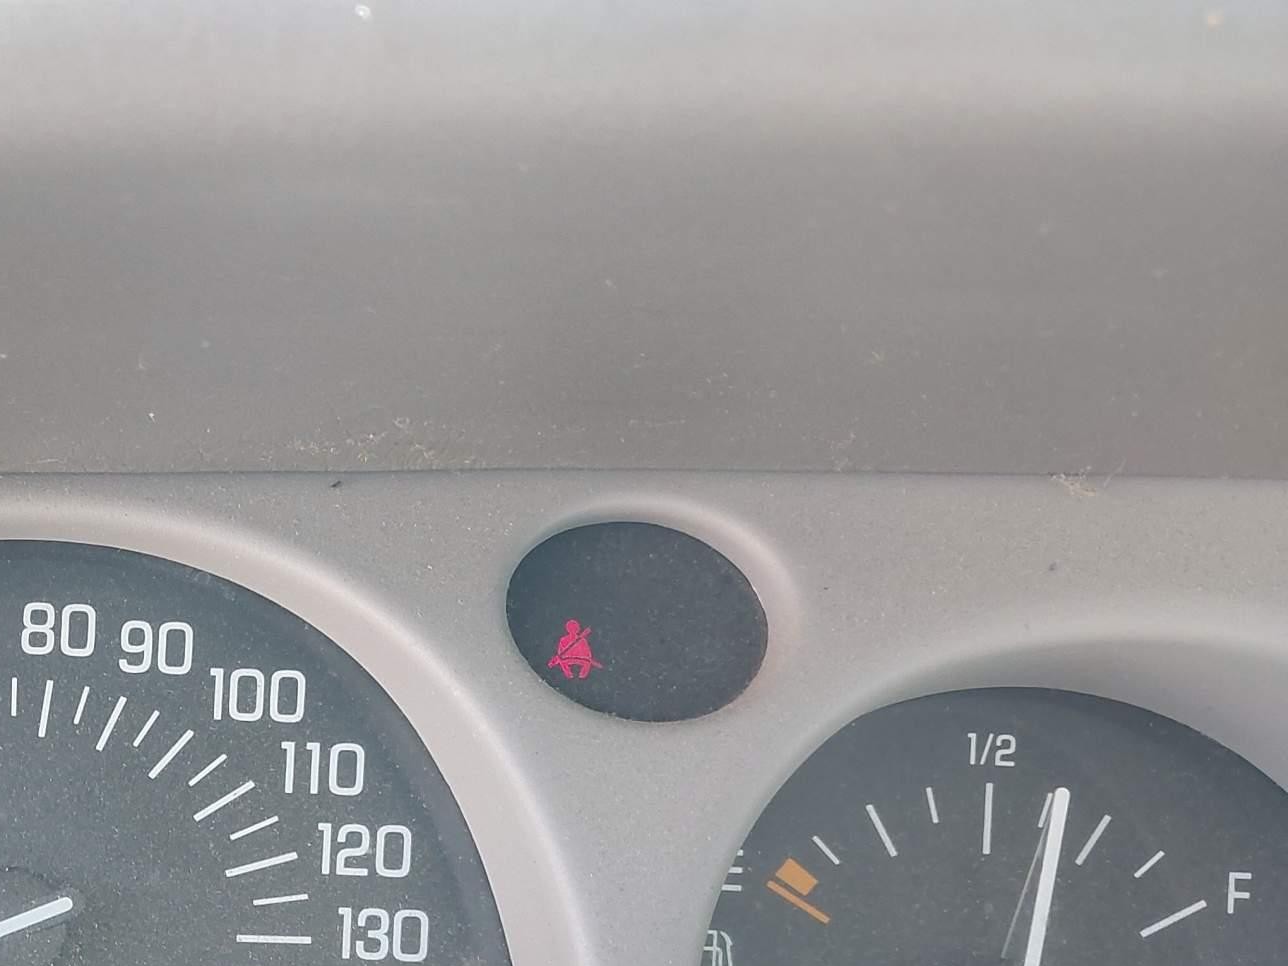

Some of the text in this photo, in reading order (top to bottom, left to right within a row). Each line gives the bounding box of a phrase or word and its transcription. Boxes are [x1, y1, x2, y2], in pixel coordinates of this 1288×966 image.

[21, 602, 96, 657] 80
[118, 620, 194, 675] 90
[210, 668, 306, 723] 100
[281, 741, 365, 796] 110
[967, 733, 1017, 767] 1/2
[317, 822, 412, 878] 120
[1227, 872, 1253, 914] F
[338, 907, 429, 962] 130
